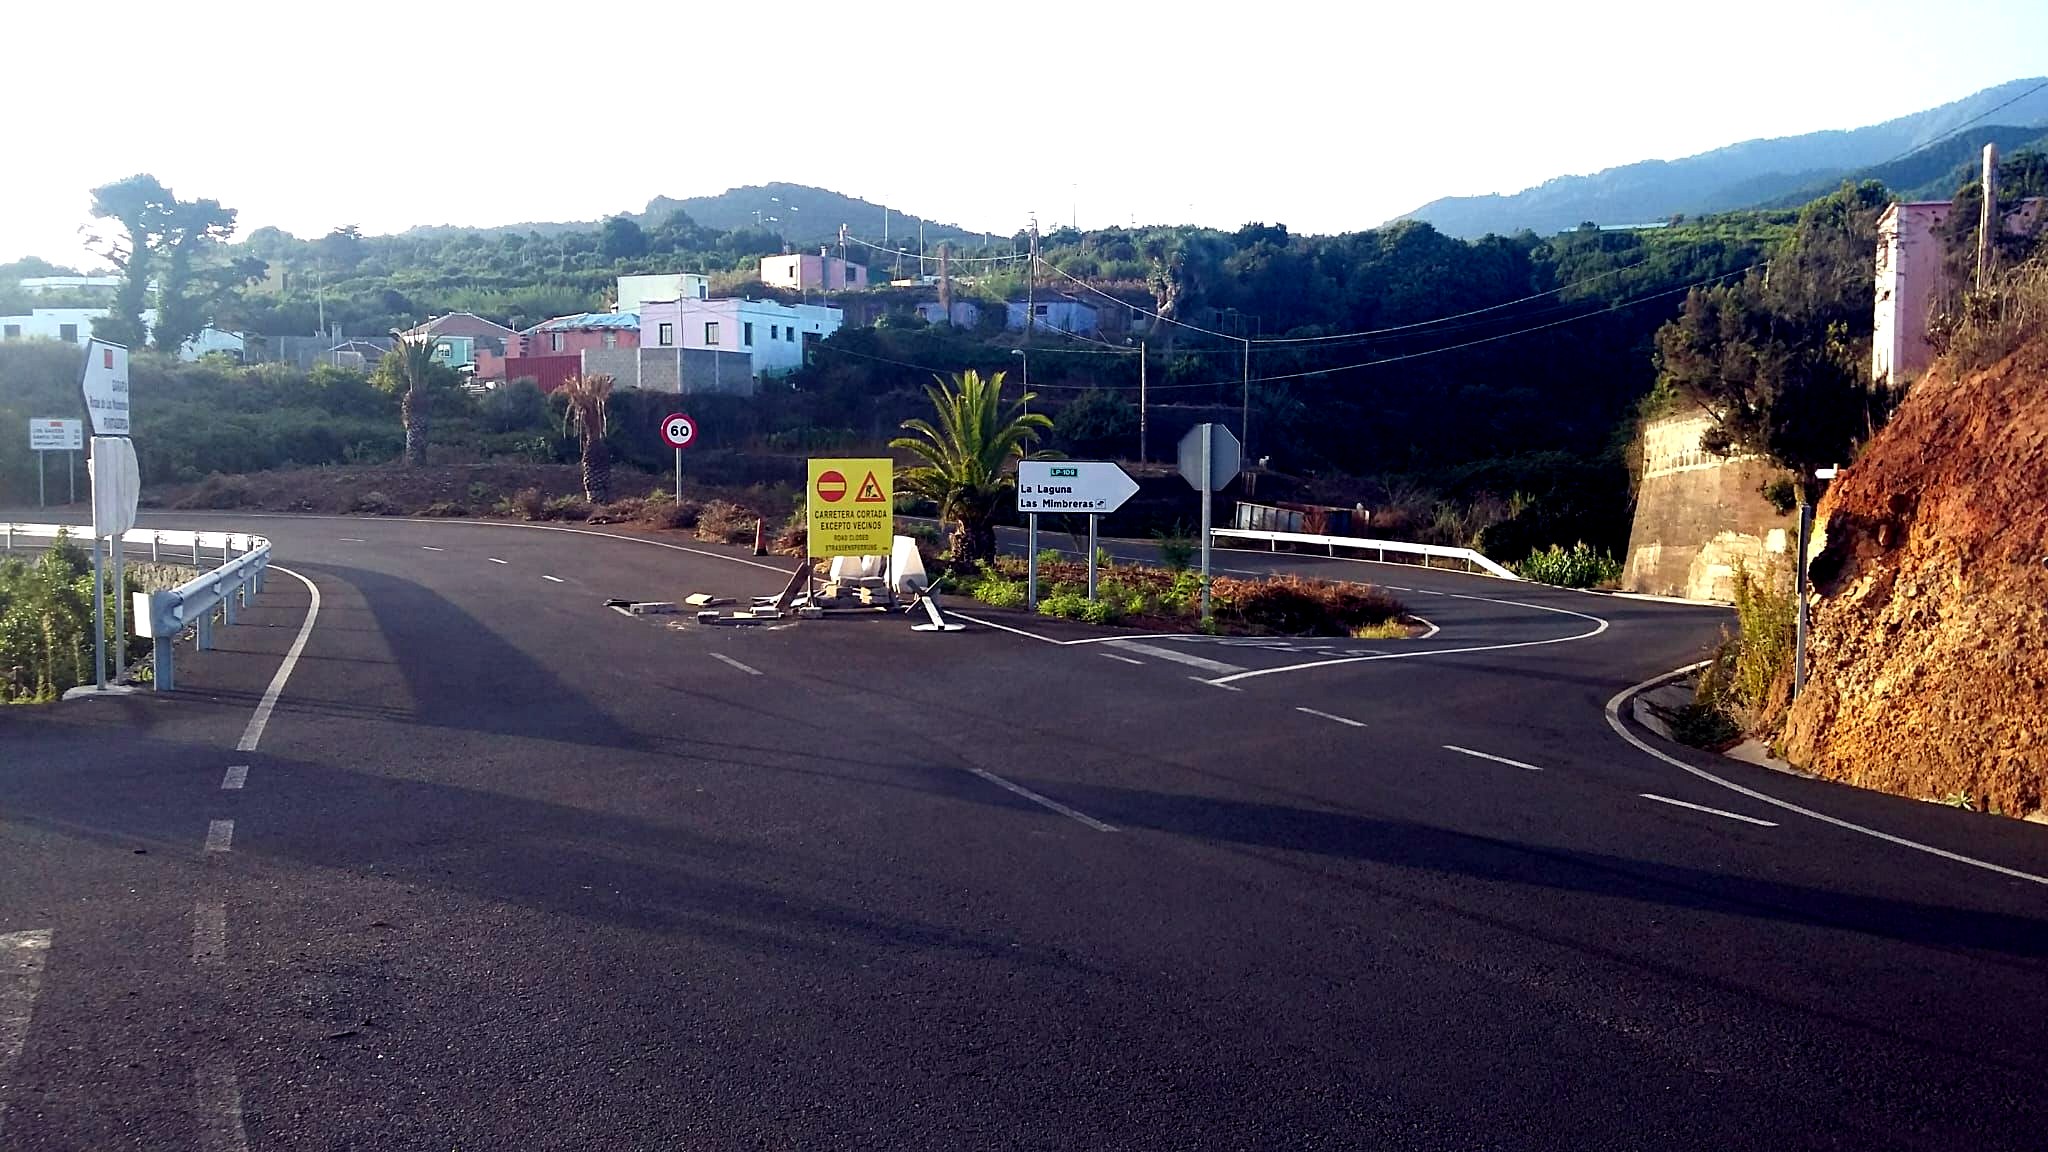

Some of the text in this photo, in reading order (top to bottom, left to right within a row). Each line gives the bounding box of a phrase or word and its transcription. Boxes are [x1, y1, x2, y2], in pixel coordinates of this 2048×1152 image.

[671, 425, 689, 437] 60
[1020, 484, 1072, 495] La Laguna
[1020, 499, 1094, 508] Las Mimbreras
[815, 510, 886, 518] CARRETERA CORTADA
[820, 522, 882, 530] EXCEPTO VECINOS
